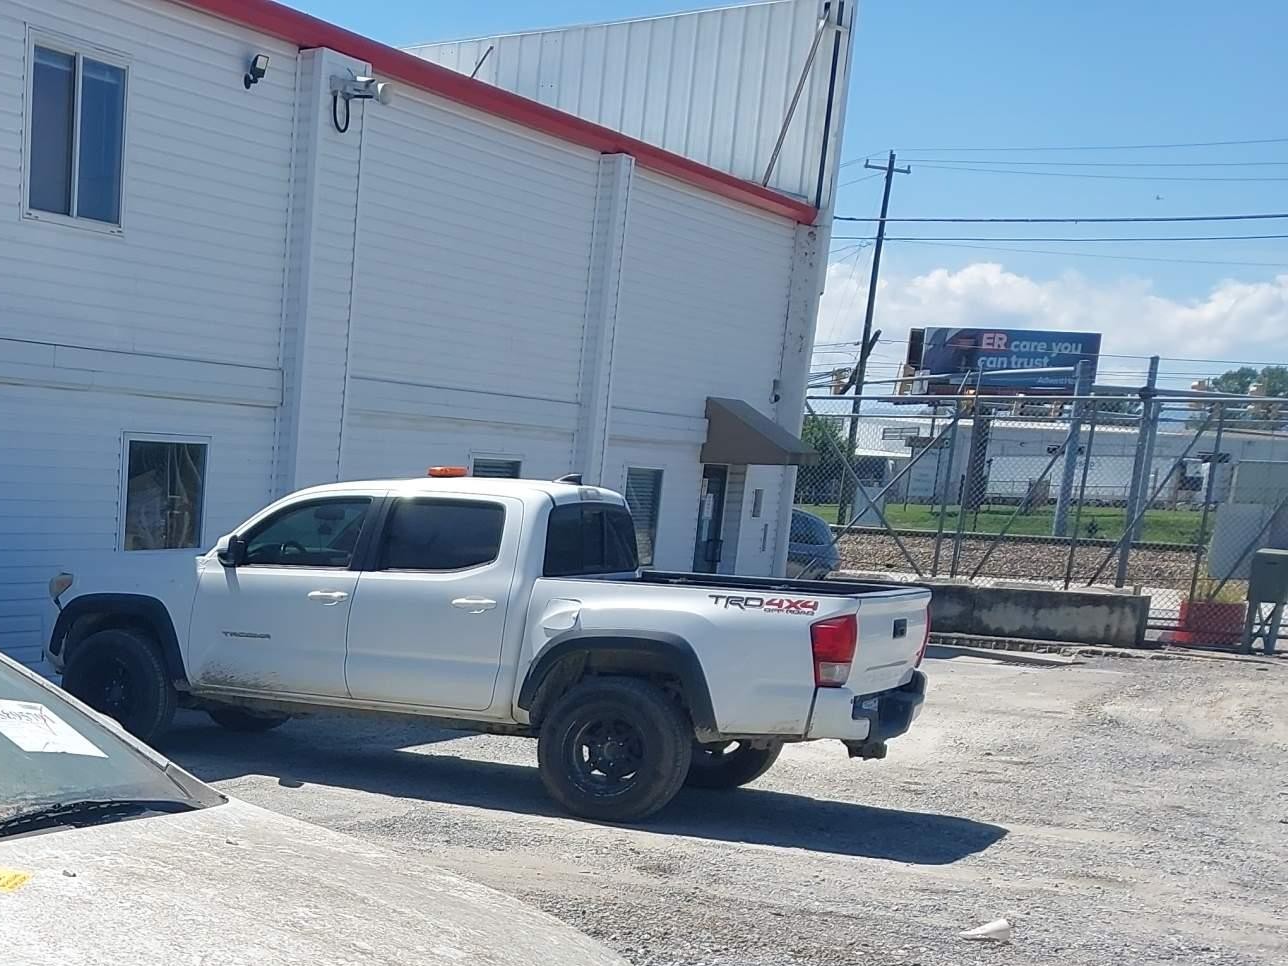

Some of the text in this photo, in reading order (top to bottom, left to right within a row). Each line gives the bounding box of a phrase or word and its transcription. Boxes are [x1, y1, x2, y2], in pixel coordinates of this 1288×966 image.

[981, 333, 1082, 358] ER care you
[977, 354, 1008, 368] can
